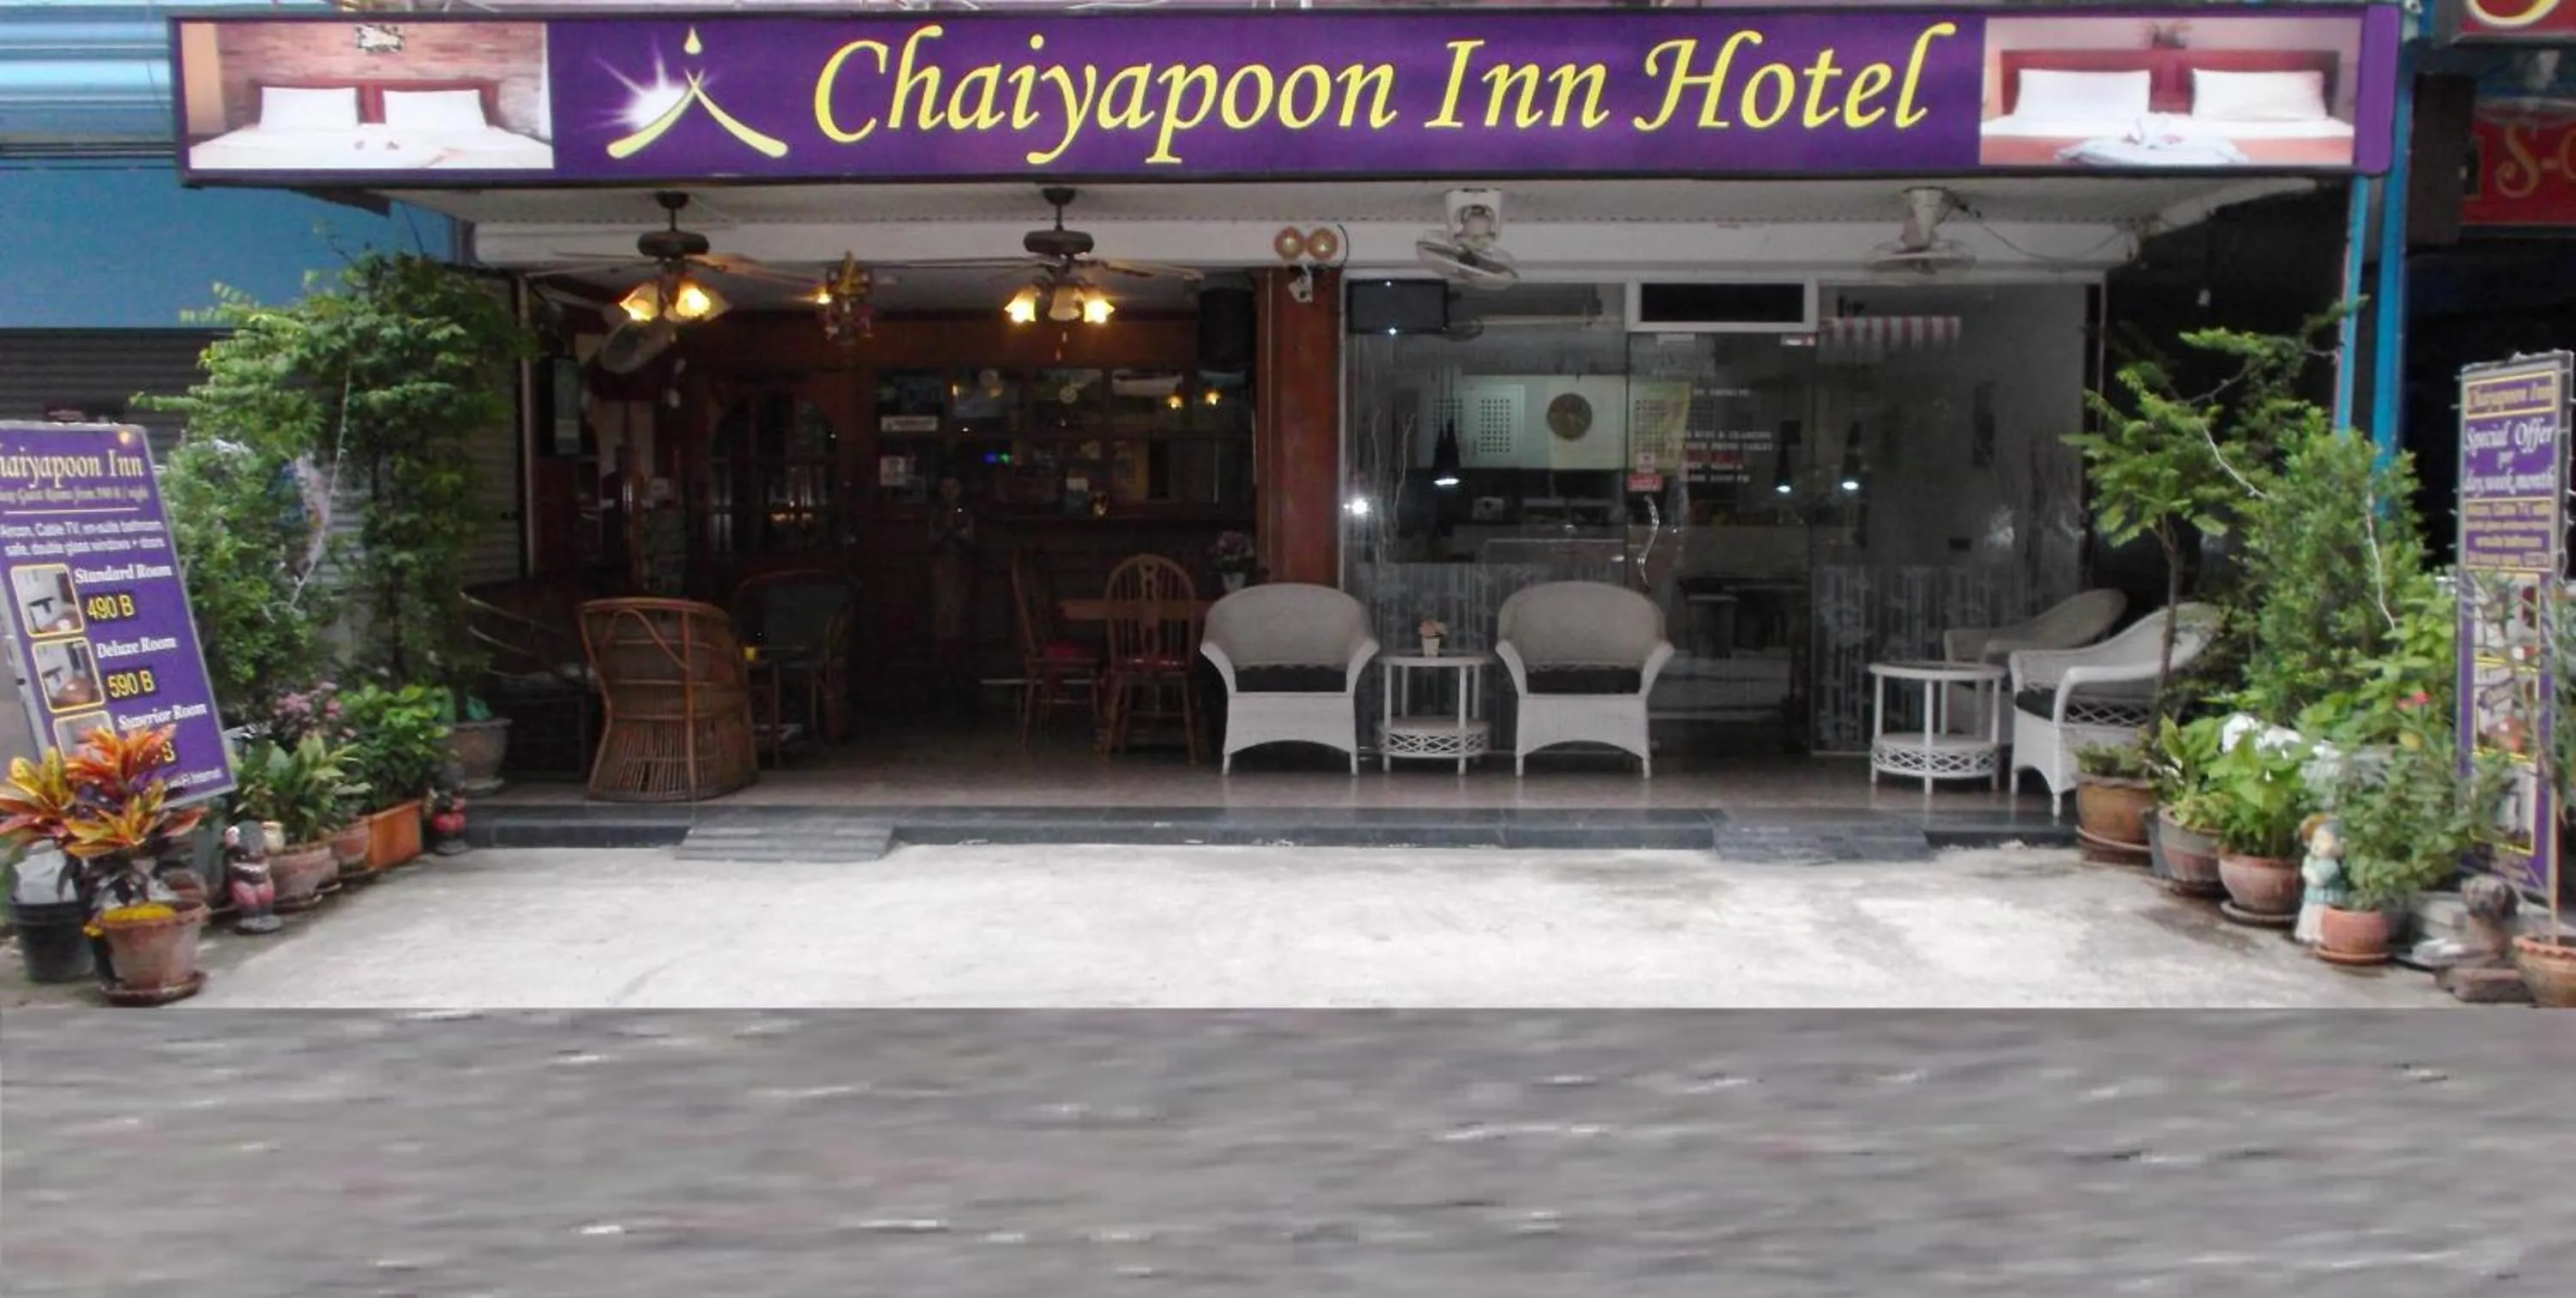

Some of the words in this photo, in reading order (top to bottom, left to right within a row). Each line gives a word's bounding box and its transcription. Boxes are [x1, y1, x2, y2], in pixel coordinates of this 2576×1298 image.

[813, 25, 1397, 165] Chaiyapoon
[1423, 39, 1607, 129] Inn
[1633, 22, 1956, 130] Hotel
[2514, 416, 2555, 454] Offer
[106, 449, 144, 478] Inn
[74, 563, 135, 584] Standard
[136, 563, 173, 579] Room
[87, 596, 118, 620] 490
[118, 593, 135, 617] B
[96, 640, 140, 658] Deluxe
[140, 636, 177, 652] Room
[107, 672, 139, 698] 590
[138, 670, 155, 693] B
[172, 703, 208, 720] Room
